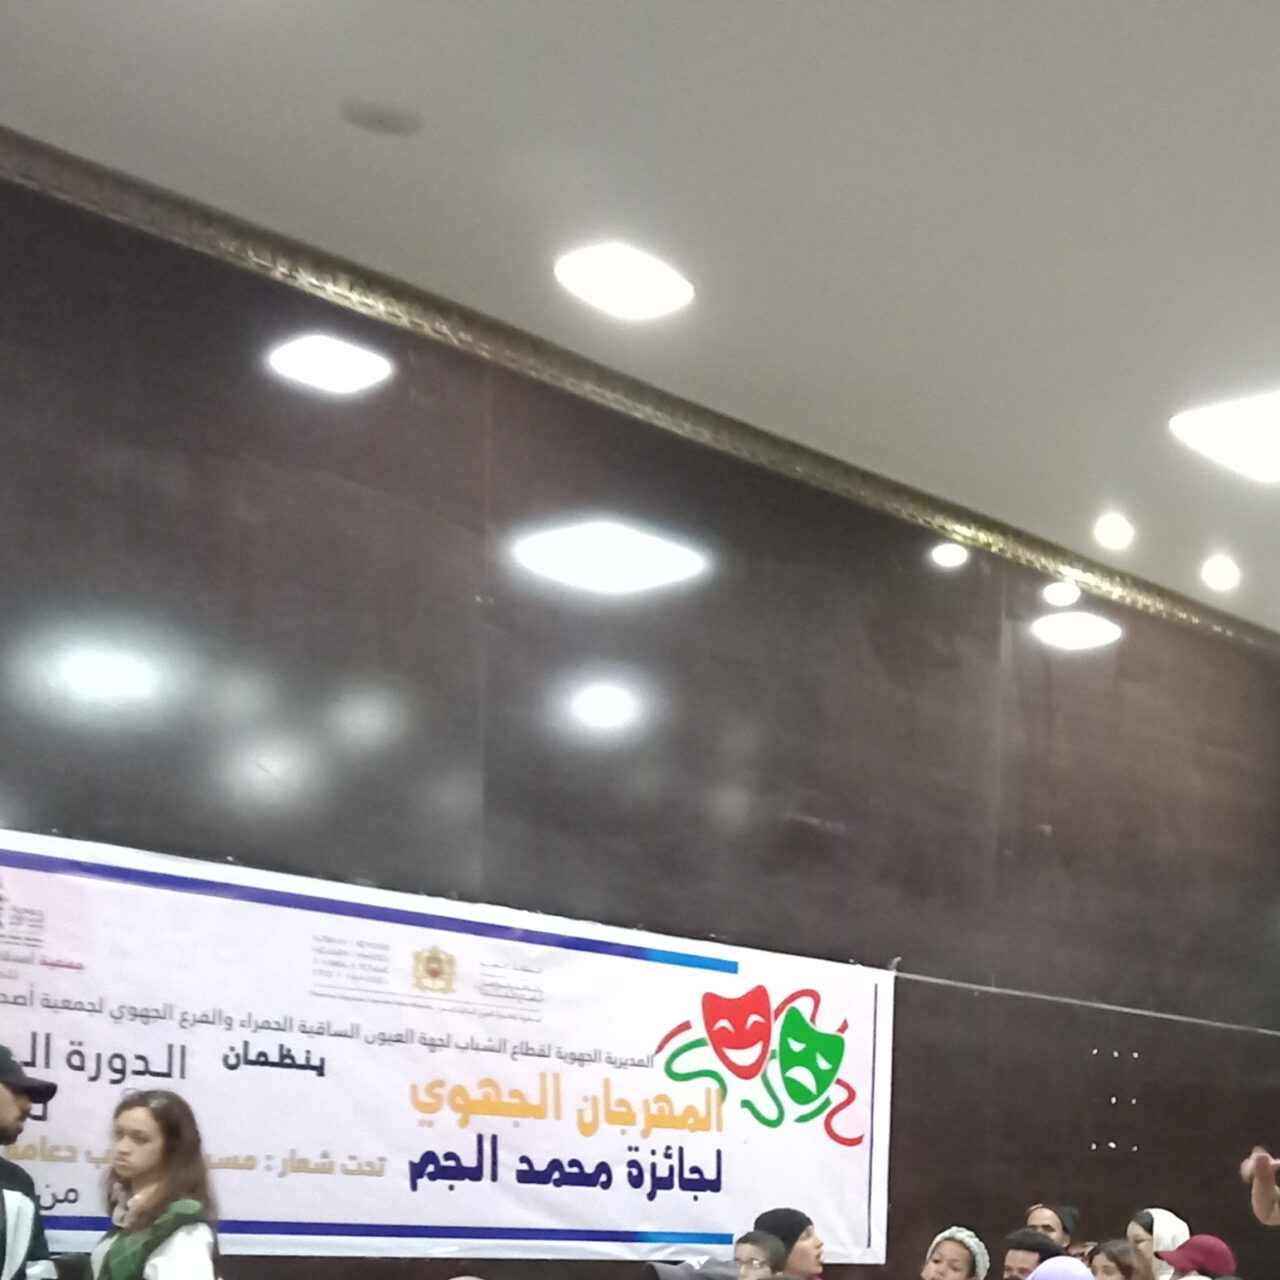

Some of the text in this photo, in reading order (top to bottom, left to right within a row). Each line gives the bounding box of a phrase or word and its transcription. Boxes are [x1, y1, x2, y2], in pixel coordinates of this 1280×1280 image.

[40, 992, 104, 1017] لجمعية
[109, 1002, 173, 1026] الجهوي
[179, 1007, 234, 1029] والفرع
[239, 1013, 293, 1033] الحمراء
[298, 1019, 361, 1042] الساقية
[364, 1026, 414, 1046] العيون
[417, 1030, 453, 1050] لجهة
[455, 1037, 507, 1056] الشباب
[510, 1041, 551, 1061] لقطاع
[555, 1046, 602, 1067] الجهوية
[65, 1040, 188, 1085] الدورة
[222, 1040, 326, 1077] ينظمان
[604, 1052, 655, 1070] المديرية
[409, 1070, 724, 1139] المهرجان الجهوي
[340, 1155, 387, 1178] تحت
[408, 1132, 722, 1202] لجائزة محمد الجم
[39, 1184, 79, 1211] من
